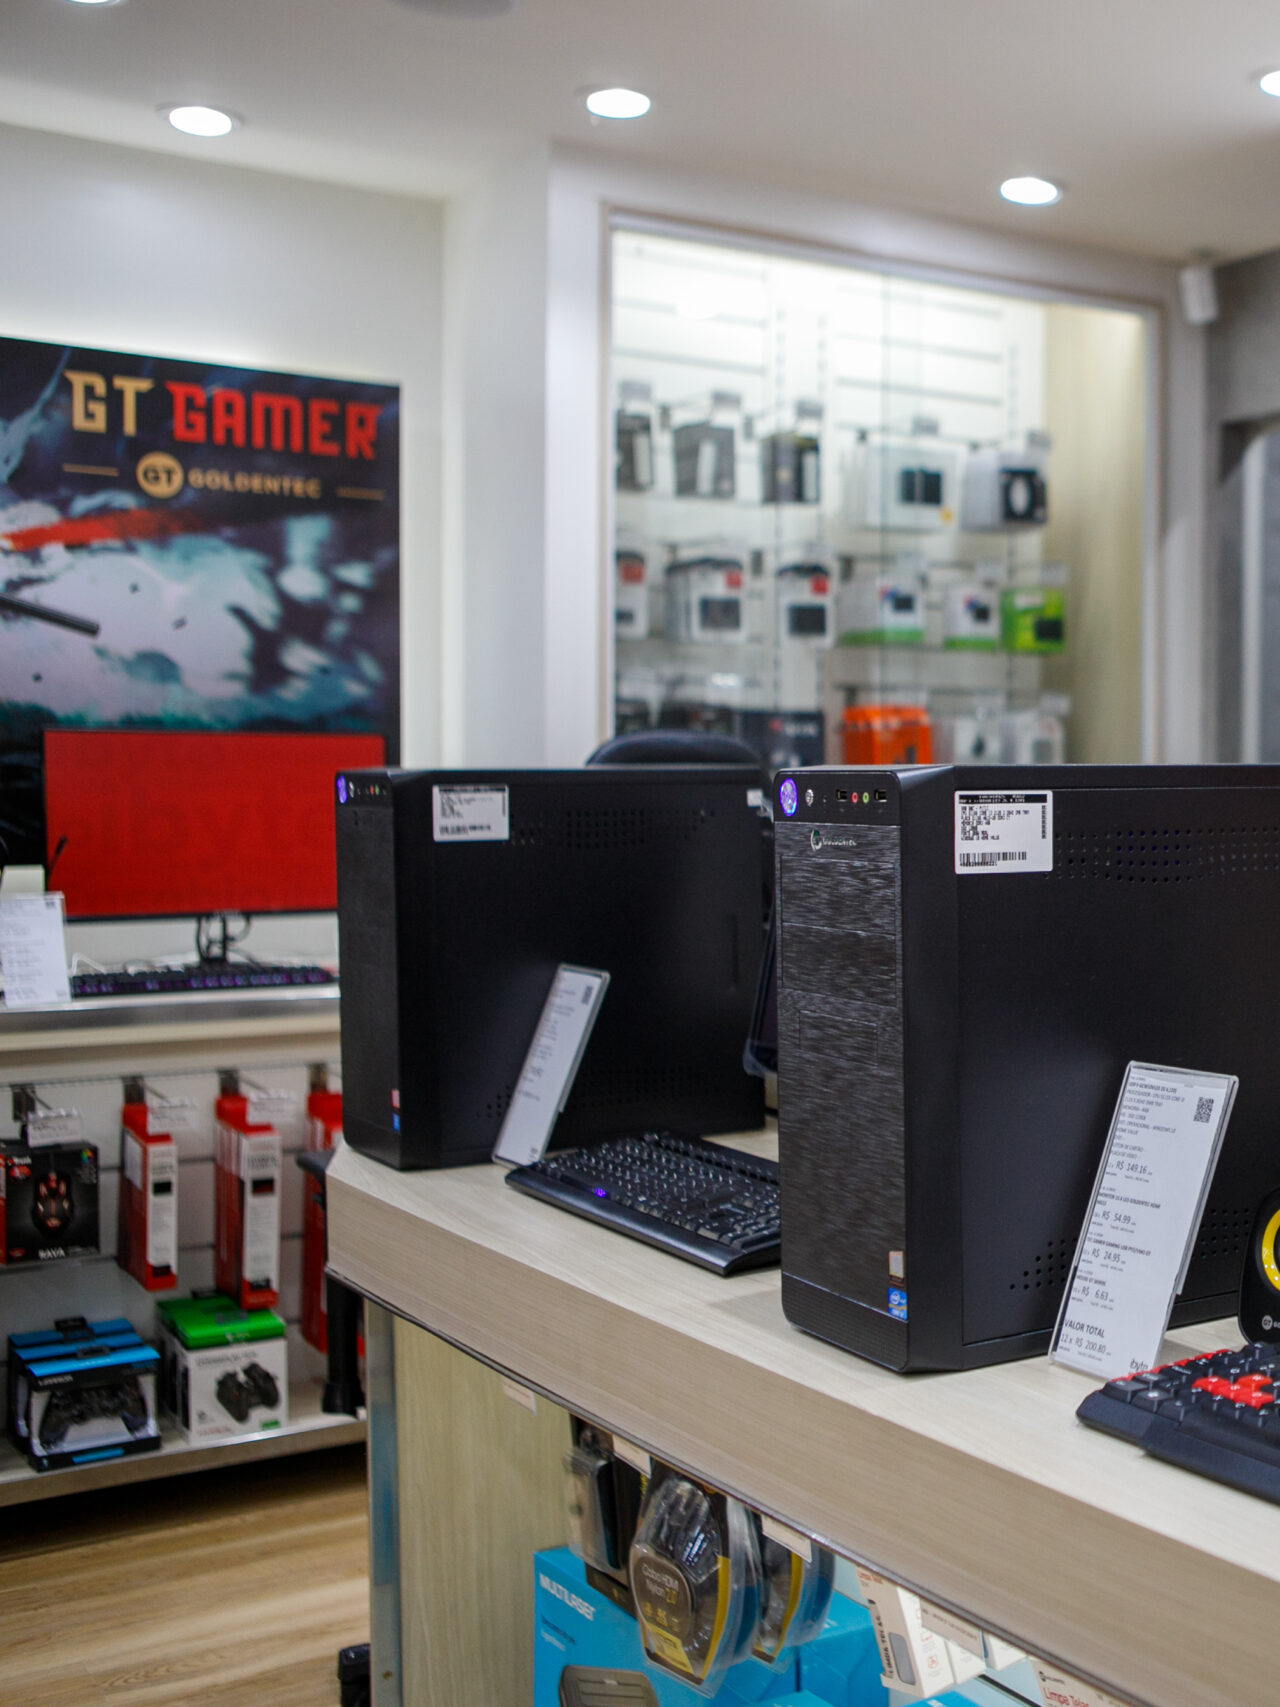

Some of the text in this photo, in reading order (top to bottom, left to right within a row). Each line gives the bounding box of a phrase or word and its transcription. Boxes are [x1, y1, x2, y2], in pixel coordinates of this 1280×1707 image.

[63, 369, 385, 460] GT GAMER
[187, 467, 321, 499] GOLDENTEC
[1063, 1320, 1105, 1338] VALOR TOTAL
